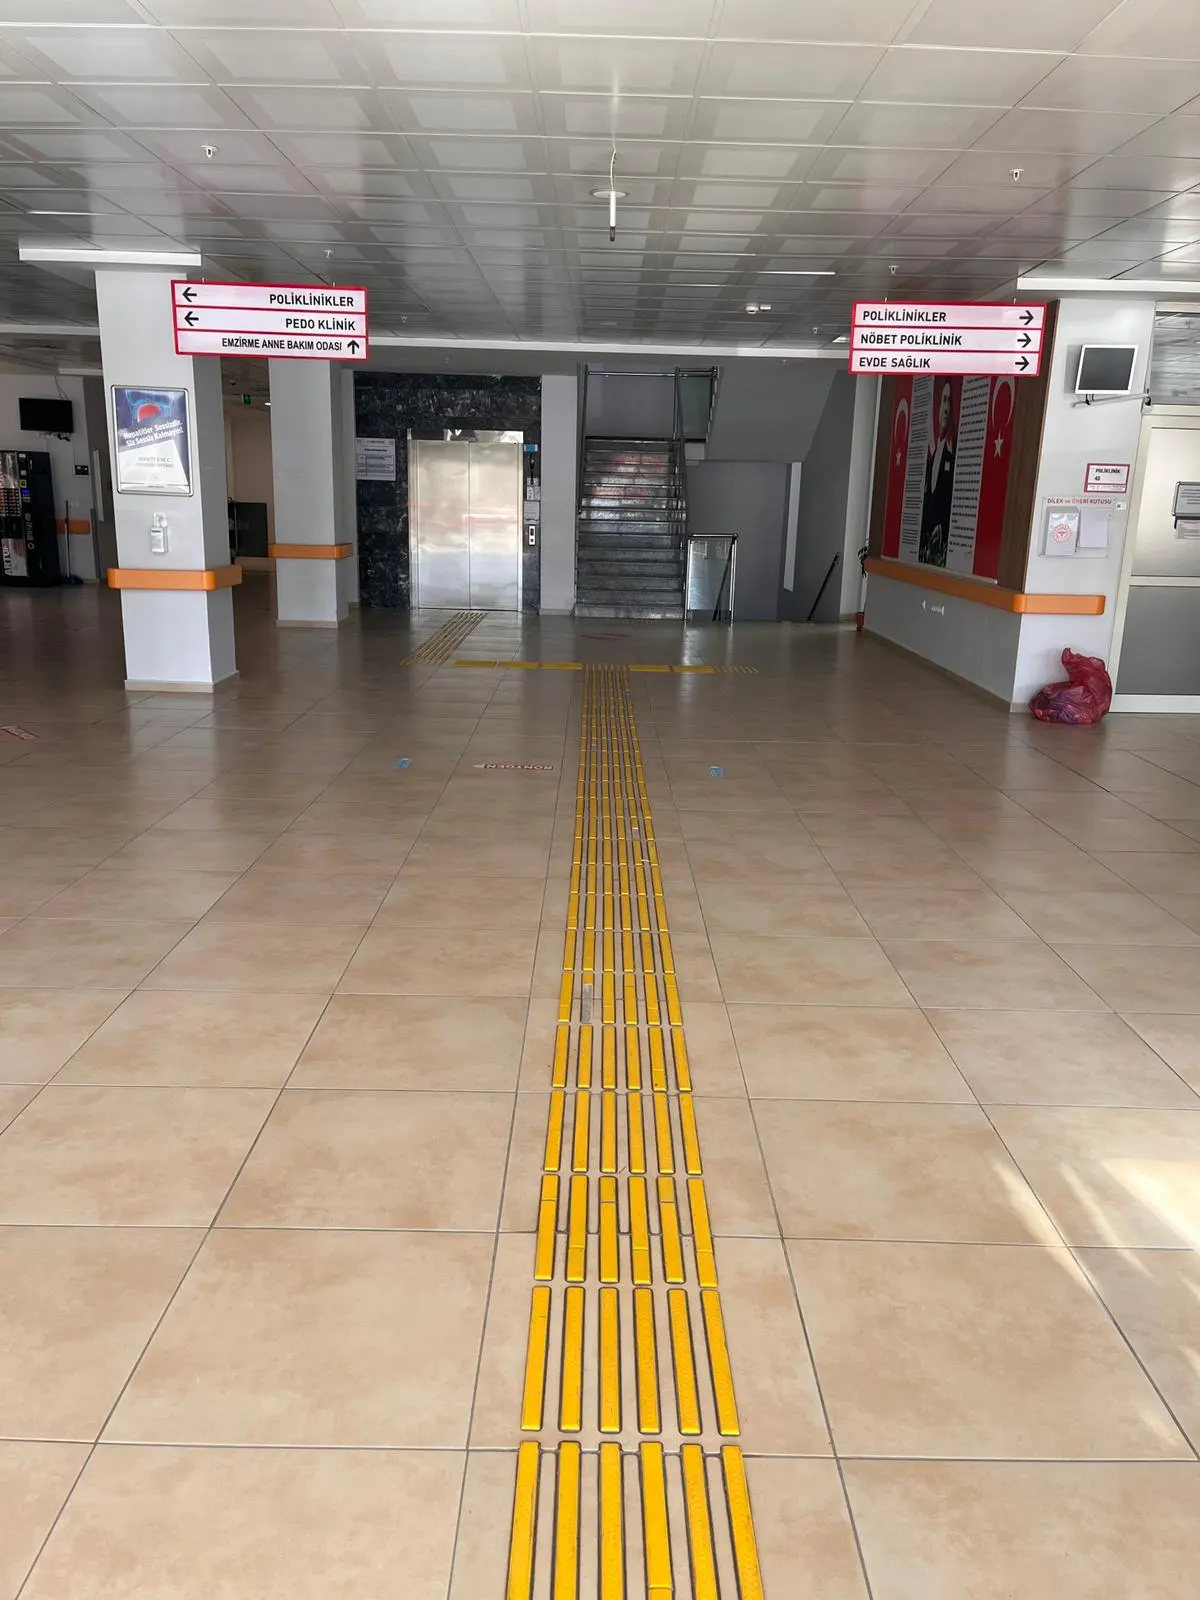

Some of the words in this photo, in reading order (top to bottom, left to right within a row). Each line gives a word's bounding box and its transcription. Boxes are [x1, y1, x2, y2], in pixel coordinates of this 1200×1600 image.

[269, 292, 354, 307] POLİKLİNİKLER
[862, 308, 947, 322] POLİKLİNİKLER
[285, 318, 315, 329] PEDO
[318, 317, 356, 331] KLİNİK
[221, 335, 260, 349] EMZİRME
[262, 339, 286, 349] ANNE
[287, 339, 314, 350] BAKIM
[315, 340, 342, 351] ODASI
[860, 331, 898, 345] NÖBET
[900, 332, 962, 346] POLİKLİNİK
[859, 357, 888, 368] EVDE
[891, 355, 931, 368] SAĞLIK
